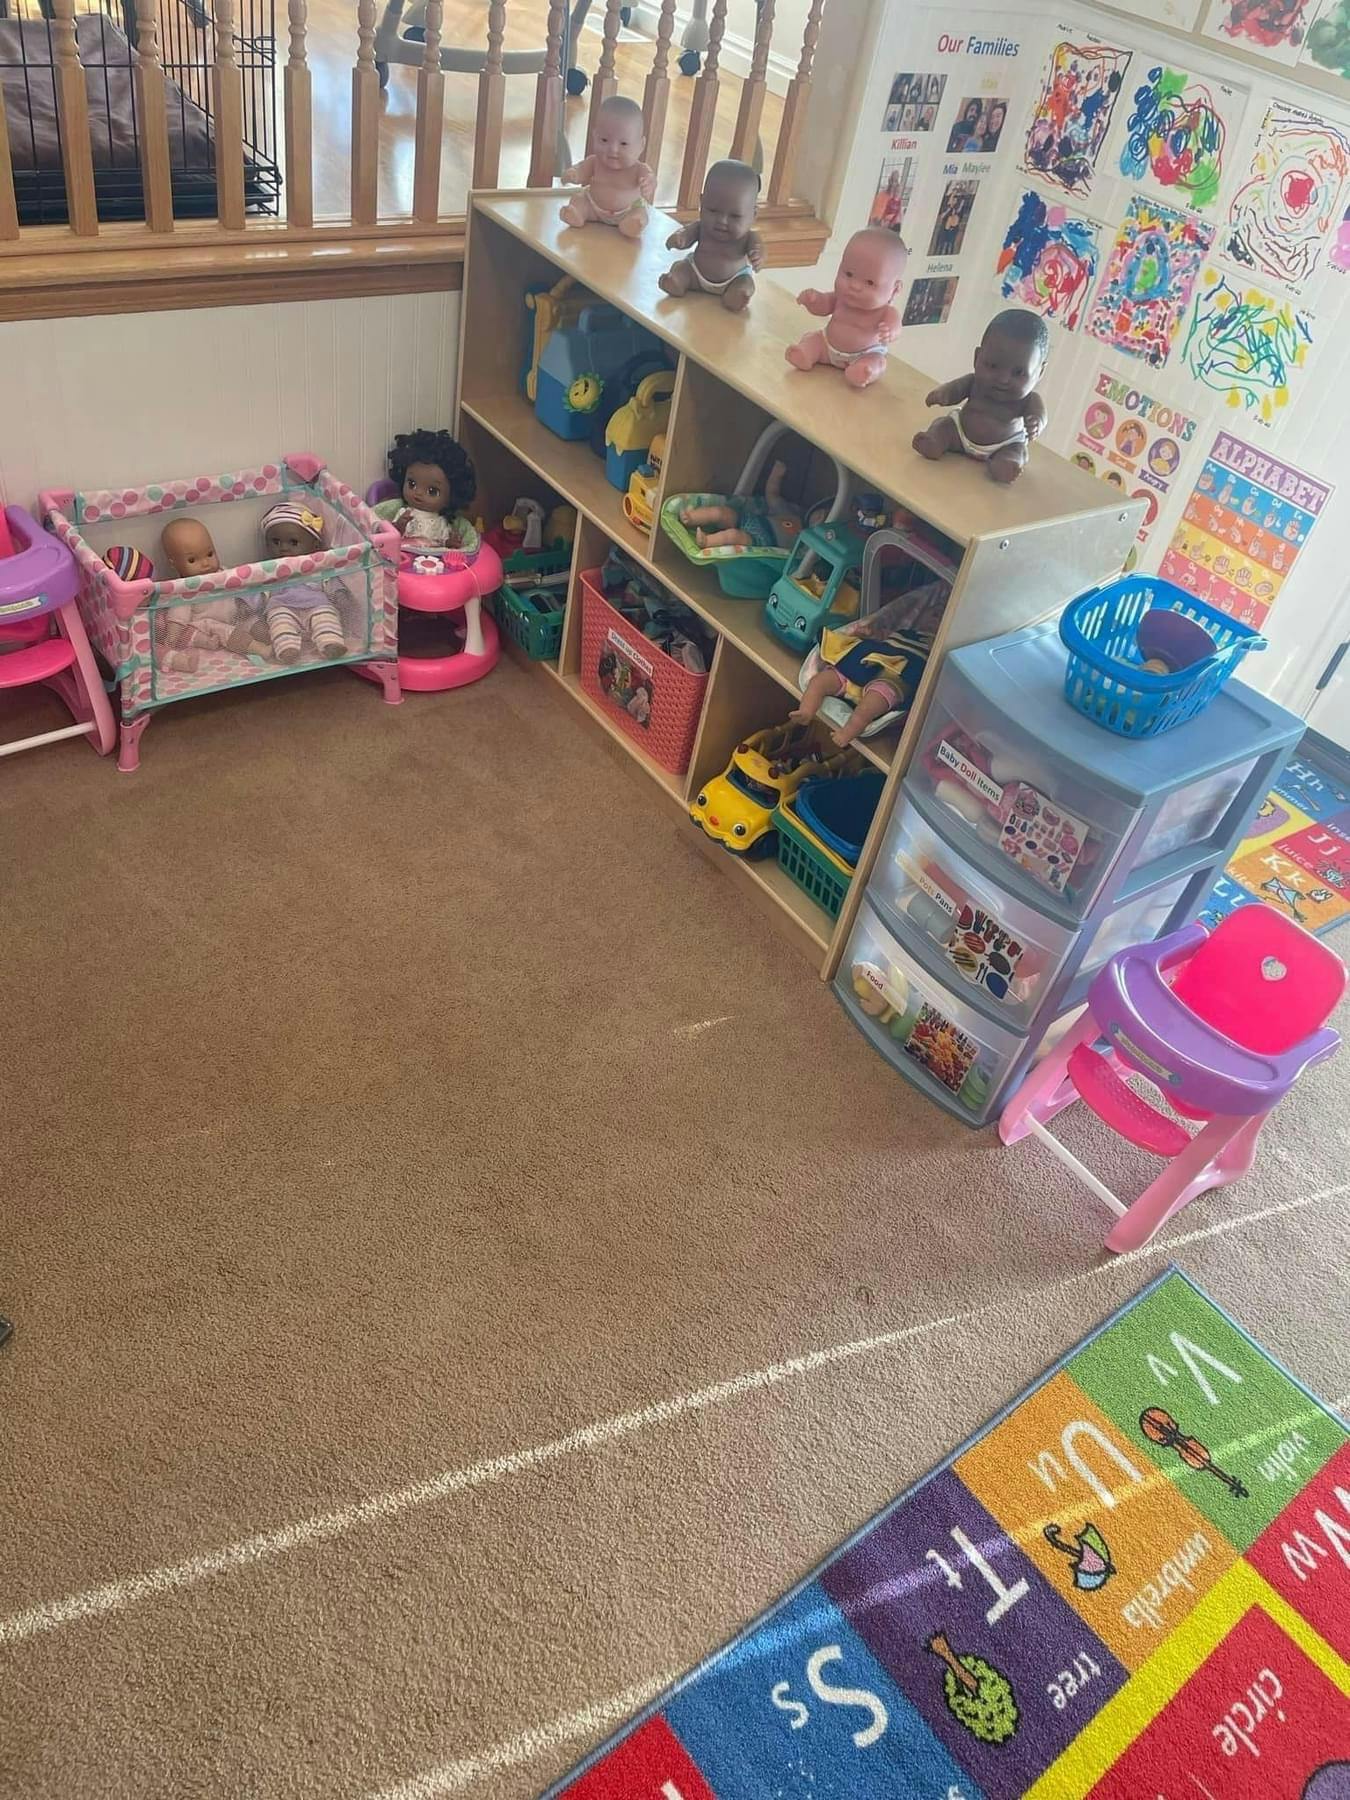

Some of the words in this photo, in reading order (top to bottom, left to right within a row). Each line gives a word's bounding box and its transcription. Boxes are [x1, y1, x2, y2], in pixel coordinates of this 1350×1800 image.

[937, 34, 964, 53] Our
[966, 36, 1020, 56] Families
[891, 138, 917, 151] Killian
[943, 163, 958, 175] Mia
[1095, 373, 1197, 442] EMOTIONS
[1211, 437, 1328, 511] ALPHABET
[940, 746, 960, 767] Baby
[960, 763, 977, 780] Doll
[977, 777, 1000, 801] Items
[1278, 844, 1314, 870] juice
[919, 876, 935, 896] Pots
[935, 892, 953, 913] Pans
[866, 970, 884, 990] Food
[1257, 1430, 1311, 1482] violin
[1121, 1531, 1213, 1629] umbrella
[1048, 1651, 1102, 1709] tree
[1212, 1668, 1287, 1757] circle
